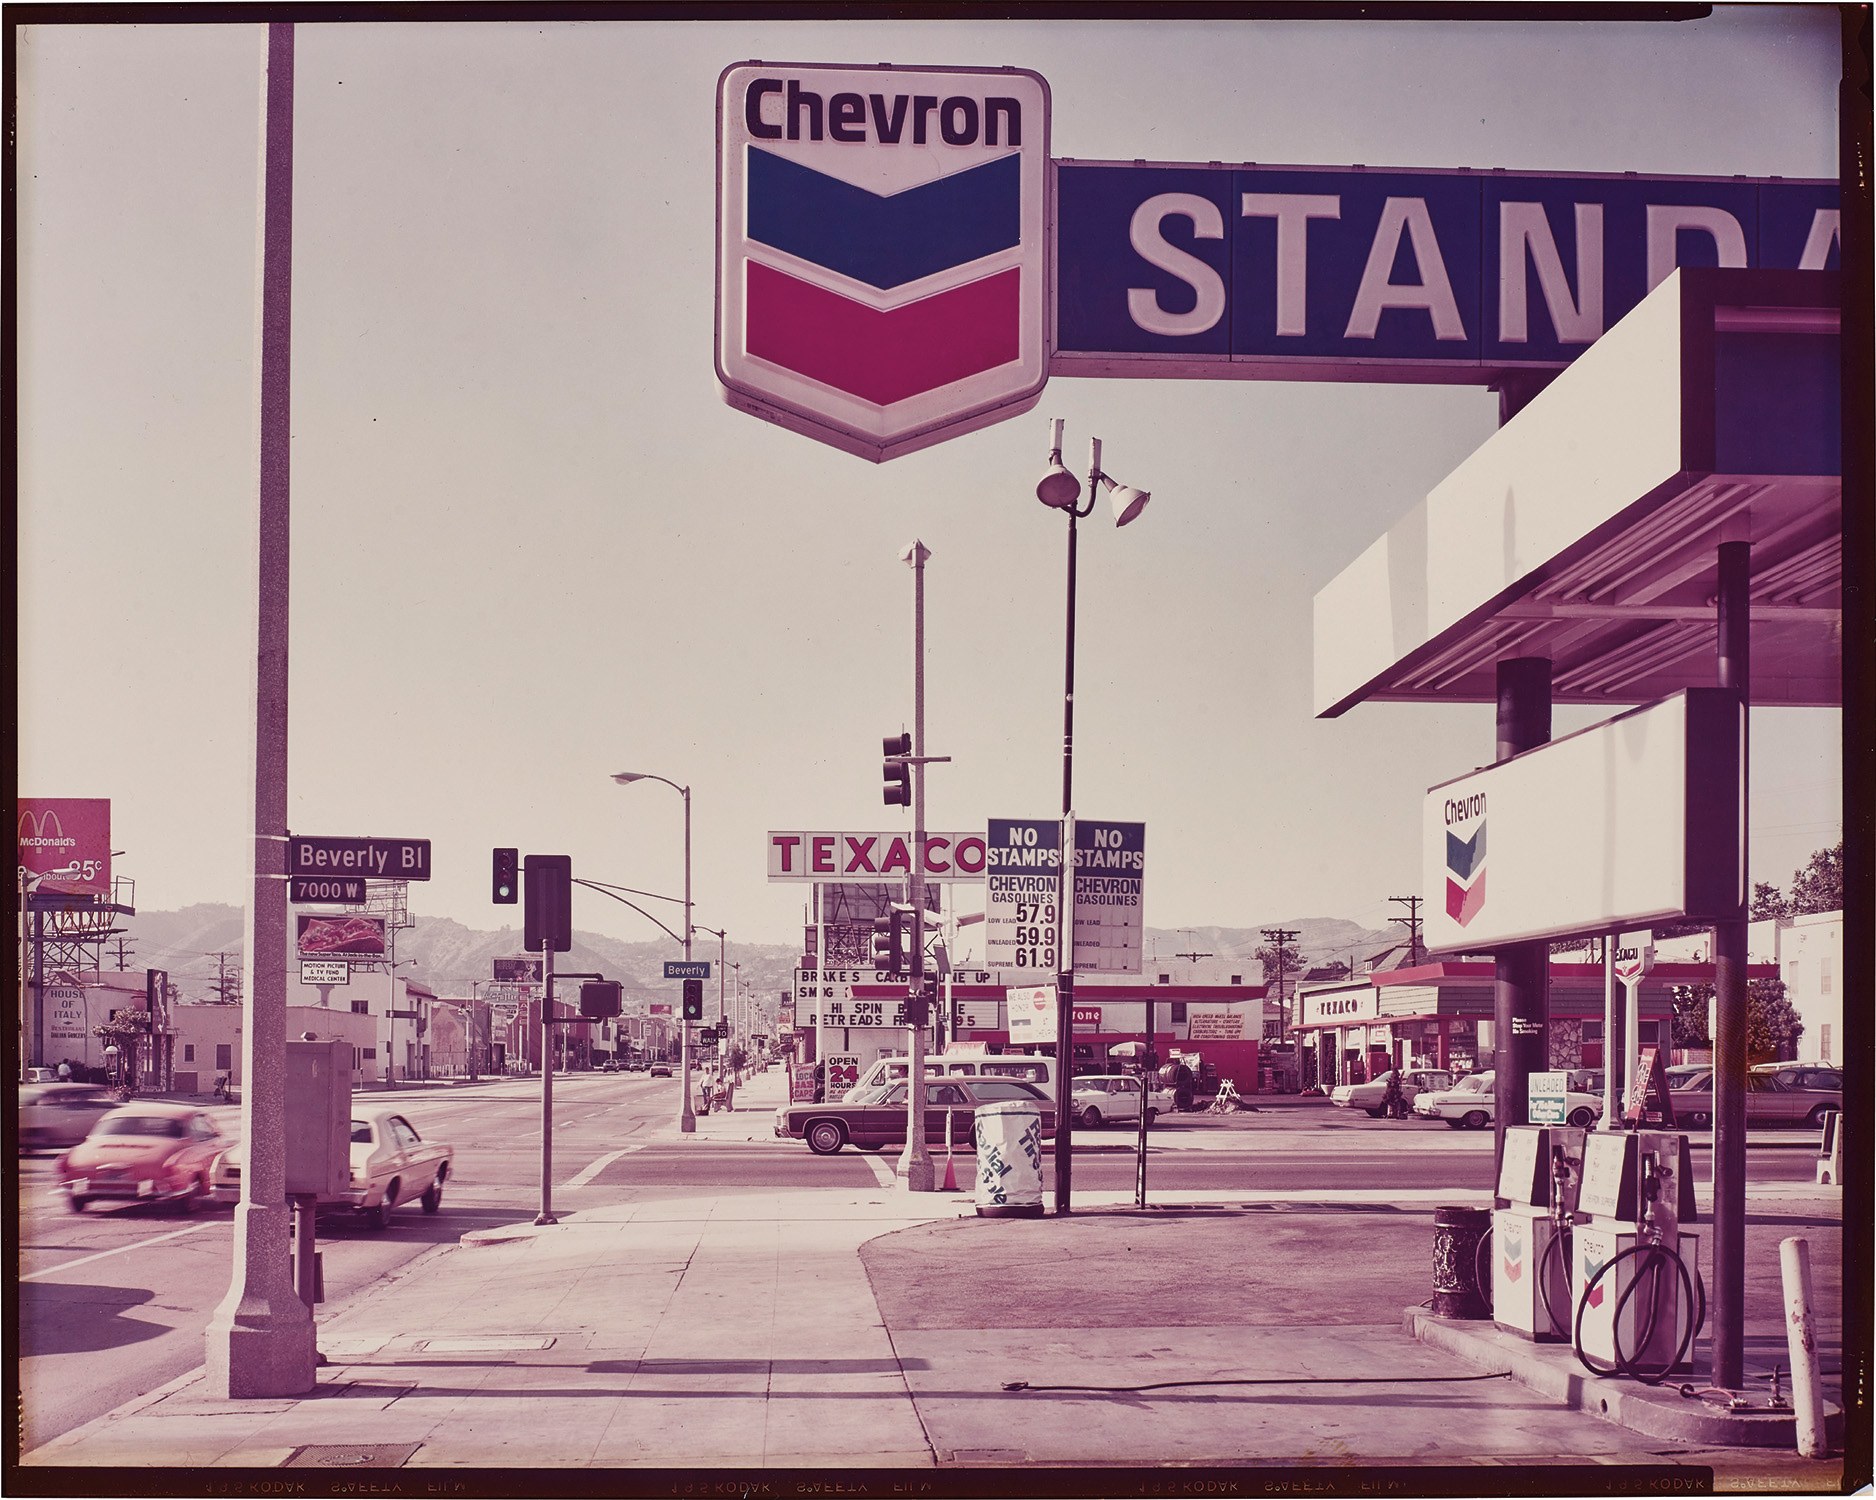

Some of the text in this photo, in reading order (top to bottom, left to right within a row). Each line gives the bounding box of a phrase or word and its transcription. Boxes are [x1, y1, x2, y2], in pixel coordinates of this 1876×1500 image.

[745, 78, 1022, 147] Chevron
[1127, 193, 1840, 344] STAND
[1444, 792, 1487, 825] Chevron
[19, 837, 76, 847] McDonald's
[1009, 827, 1038, 846] NO
[1094, 828, 1123, 848] NO
[299, 844, 422, 874] Beverly Bl
[772, 836, 986, 873] TEXACO
[988, 847, 1059, 867] STAMPS
[1074, 848, 1144, 870] STAMPS
[298, 882, 358, 898] 7000 W
[989, 875, 1057, 892] CHEVRON
[1075, 877, 1141, 895] CHEVRON
[992, 892, 1054, 904] GASOLINES
[1076, 894, 1138, 907] GASOLINES
[1016, 903, 1056, 924] 57.9
[1016, 926, 1056, 946] 59.9
[1015, 947, 1055, 968] 61.9
[668, 965, 706, 977] Beverly
[801, 971, 860, 983] BRAKES
[975, 973, 991, 984] UP
[799, 986, 834, 998] SMG
[61, 1000, 76, 1009] OF
[831, 1003, 883, 1014] HI SPIN
[1320, 999, 1358, 1016] TEXACO
[54, 1010, 82, 1019] ITALY
[810, 1014, 883, 1026] RETREADS
[829, 1057, 859, 1066] OPEN
[829, 1065, 860, 1083] 24
[794, 1089, 814, 1098] CAPS
